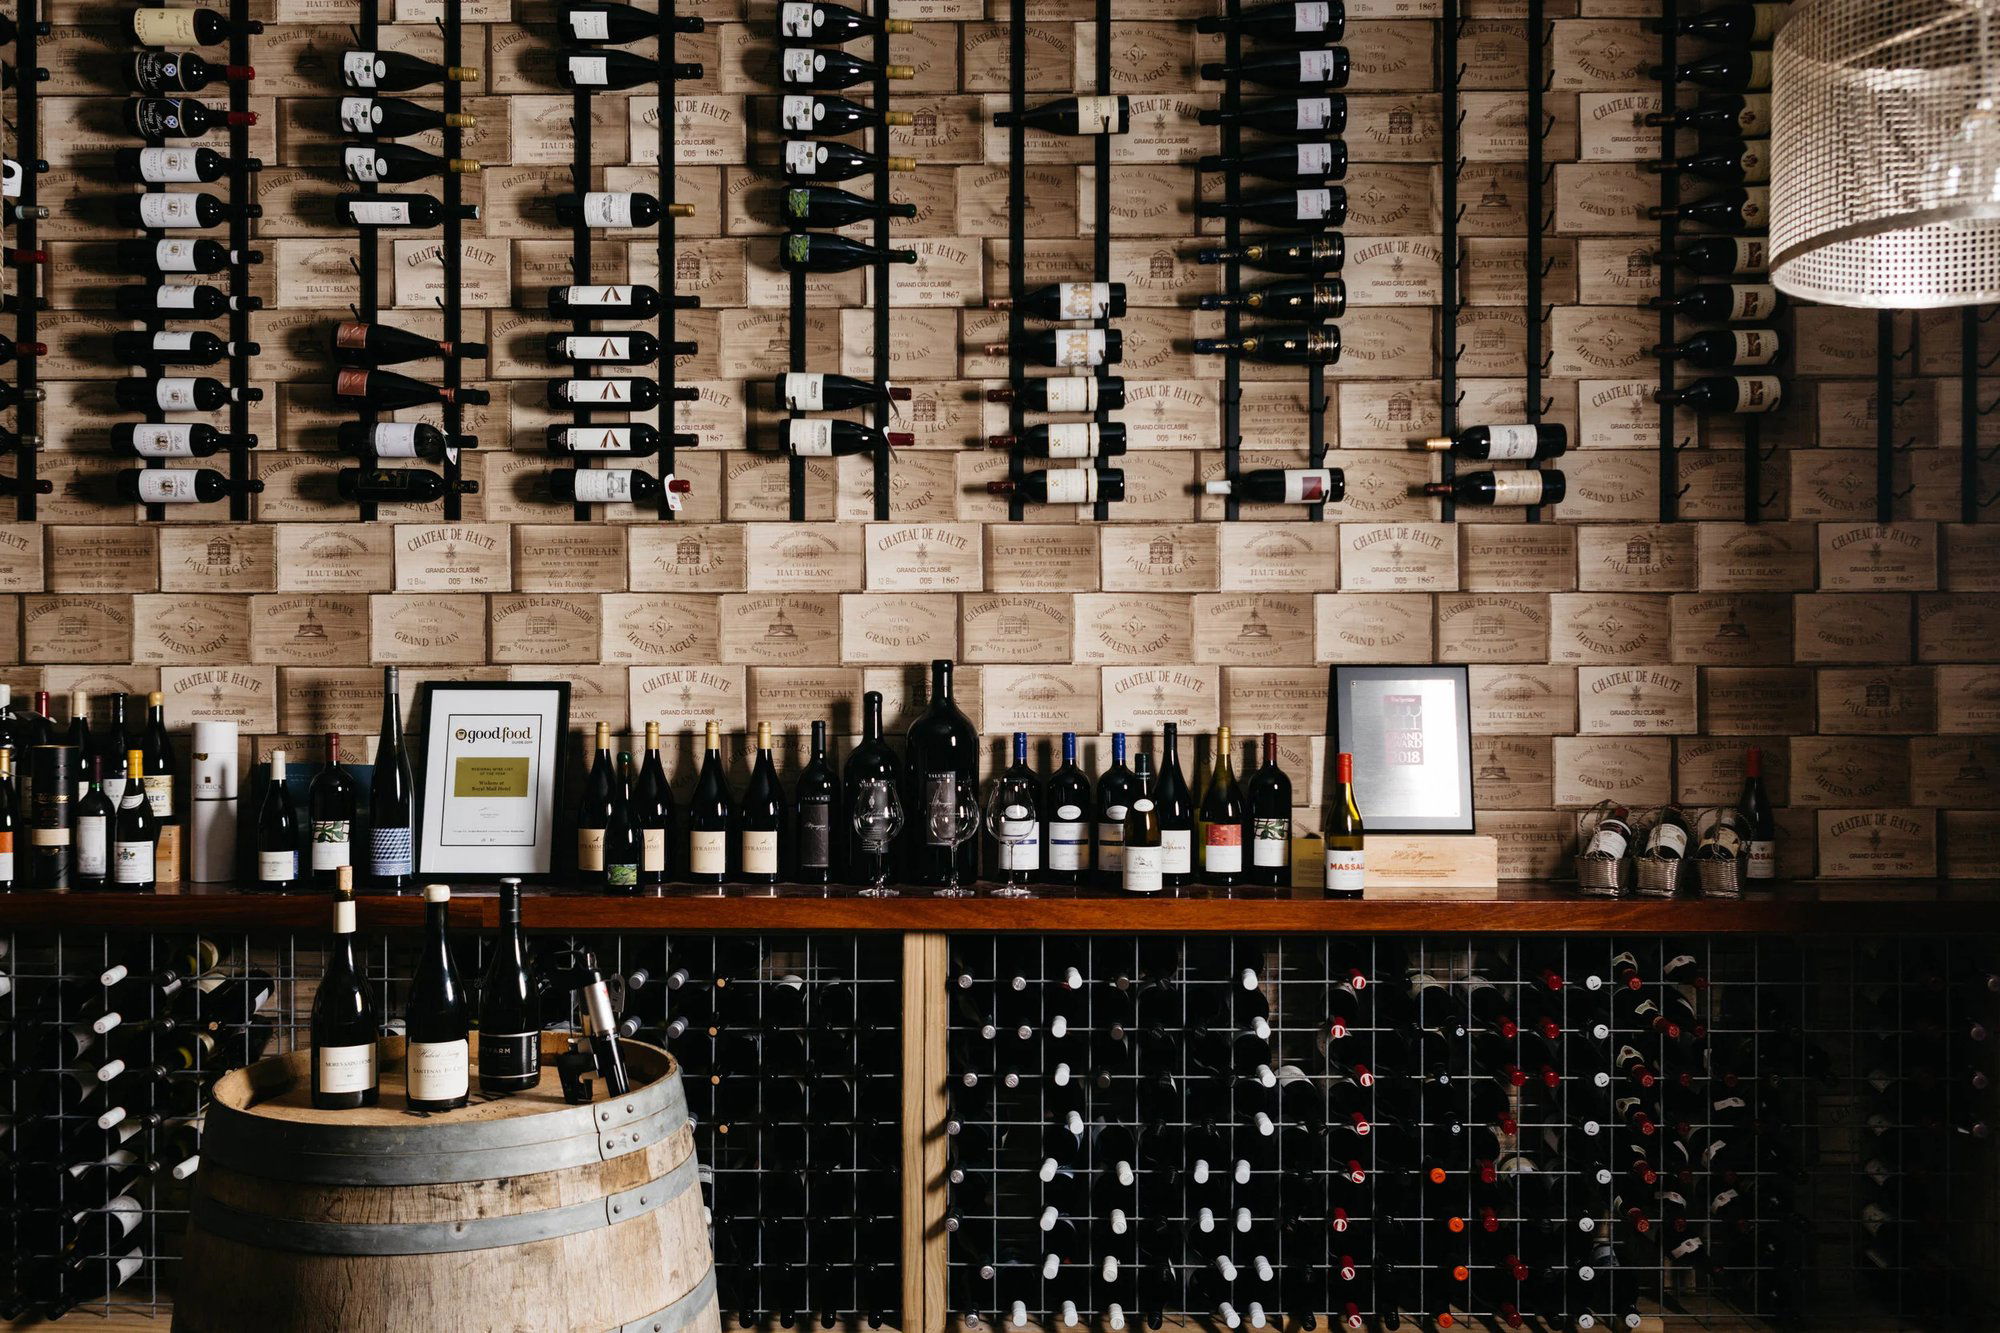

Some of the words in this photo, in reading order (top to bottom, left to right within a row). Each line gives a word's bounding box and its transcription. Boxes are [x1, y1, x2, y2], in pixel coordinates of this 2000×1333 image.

[1365, 126, 1392, 146] PAUL
[1126, 270, 1153, 290] PAUL
[942, 291, 960, 299] 1867
[1418, 289, 1436, 297] 1867
[1364, 412, 1391, 432] PAUL
[1179, 433, 1197, 441] 1867
[1579, 487, 1615, 504] GRAND
[451, 528, 462, 541] DE
[922, 527, 933, 540] DE
[936, 530, 968, 551] HAUTE
[1397, 527, 1408, 540] DE
[1411, 530, 1443, 551] HAUTE
[653, 556, 680, 576] PAUL
[1126, 556, 1153, 576] PAUL
[1603, 555, 1630, 575] PAUL
[97, 580, 126, 590] Rouge
[942, 576, 960, 584] 1867
[1037, 579, 1066, 589] Rouge
[1417, 576, 1435, 584] 1867
[776, 598, 786, 607] DE
[789, 598, 799, 608] LA
[1023, 598, 1067, 624] SPLENDIDE
[1250, 598, 1260, 607] DE
[1263, 598, 1273, 608] LA
[1499, 598, 1543, 624] SPLENDIDE
[83, 599, 127, 625] SPLENDIDE
[865, 630, 901, 647] GRAND
[1340, 630, 1376, 647] GRAND
[217, 670, 228, 683] DE
[1159, 670, 1170, 683] DE
[1173, 673, 1205, 694] HAUTE
[1636, 670, 1647, 683] DE
[1650, 673, 1682, 694] HAUTE
[1656, 719, 1674, 727] 1867
[1875, 813, 1886, 826] DE
